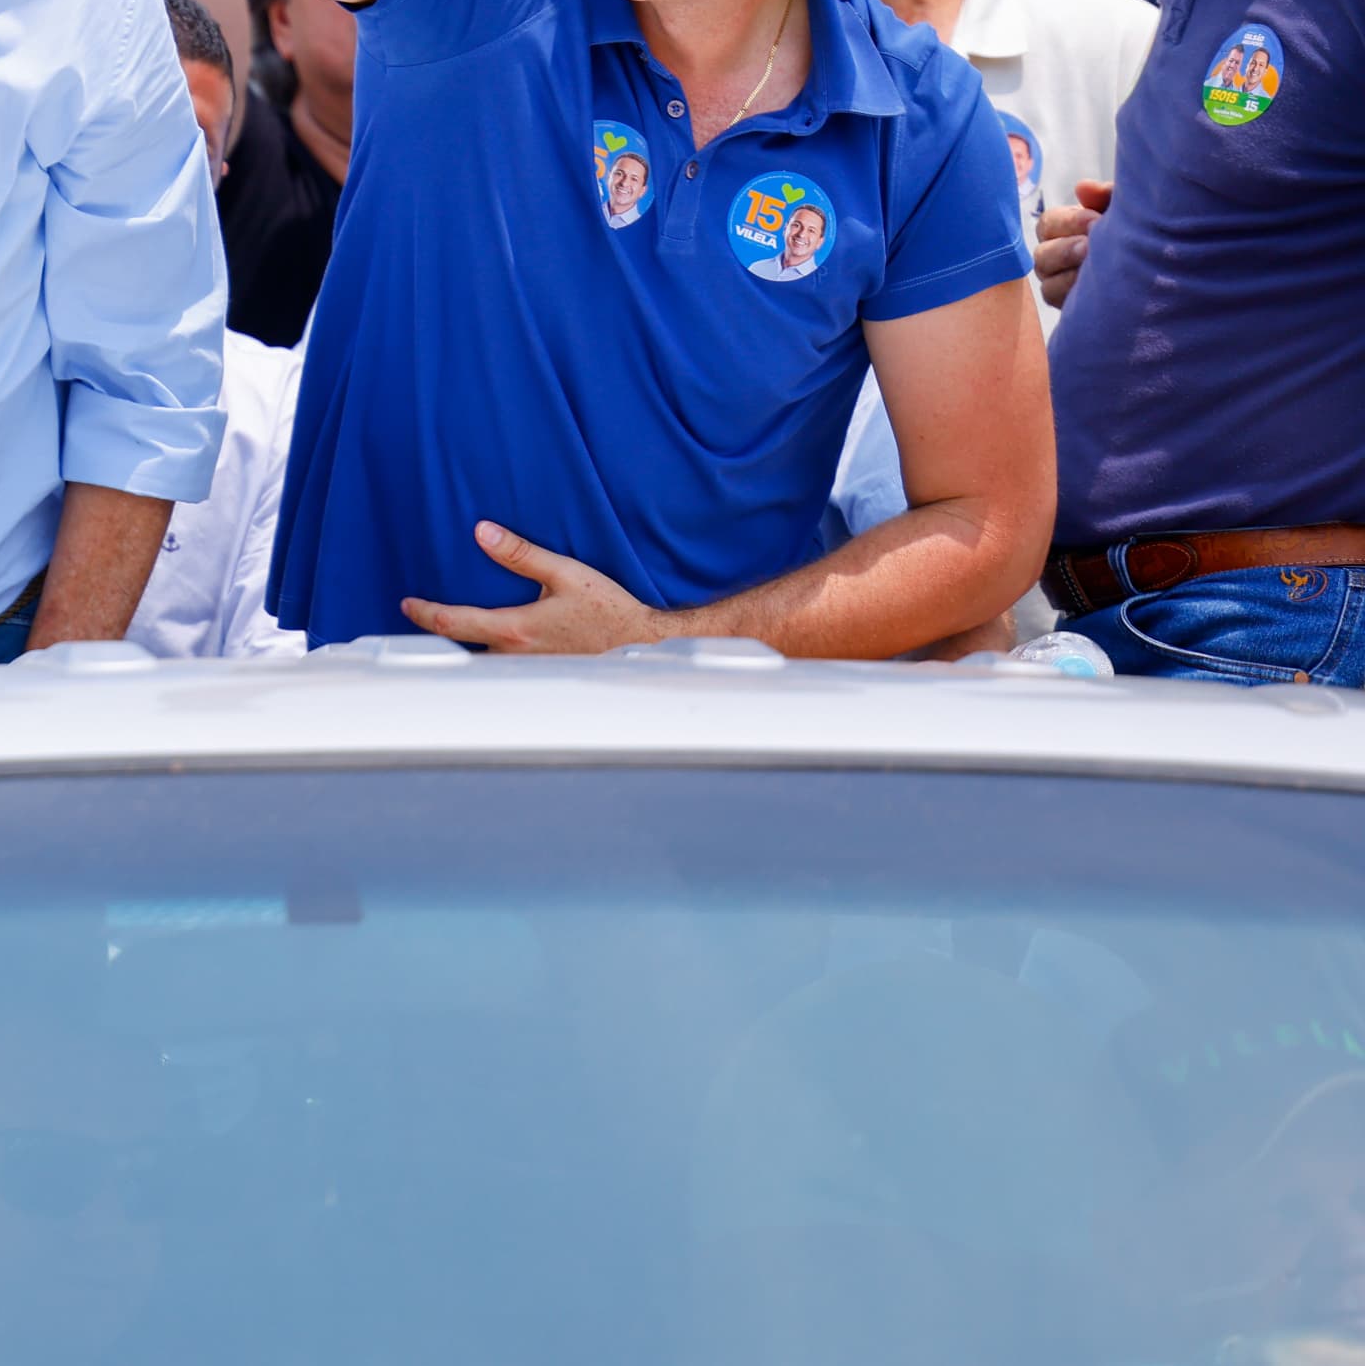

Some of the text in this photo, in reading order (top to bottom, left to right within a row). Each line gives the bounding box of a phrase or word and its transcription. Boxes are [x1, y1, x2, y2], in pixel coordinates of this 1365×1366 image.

[1243, 99, 1260, 113] 15
[747, 189, 787, 232] 15
[734, 224, 777, 249] VILELA
